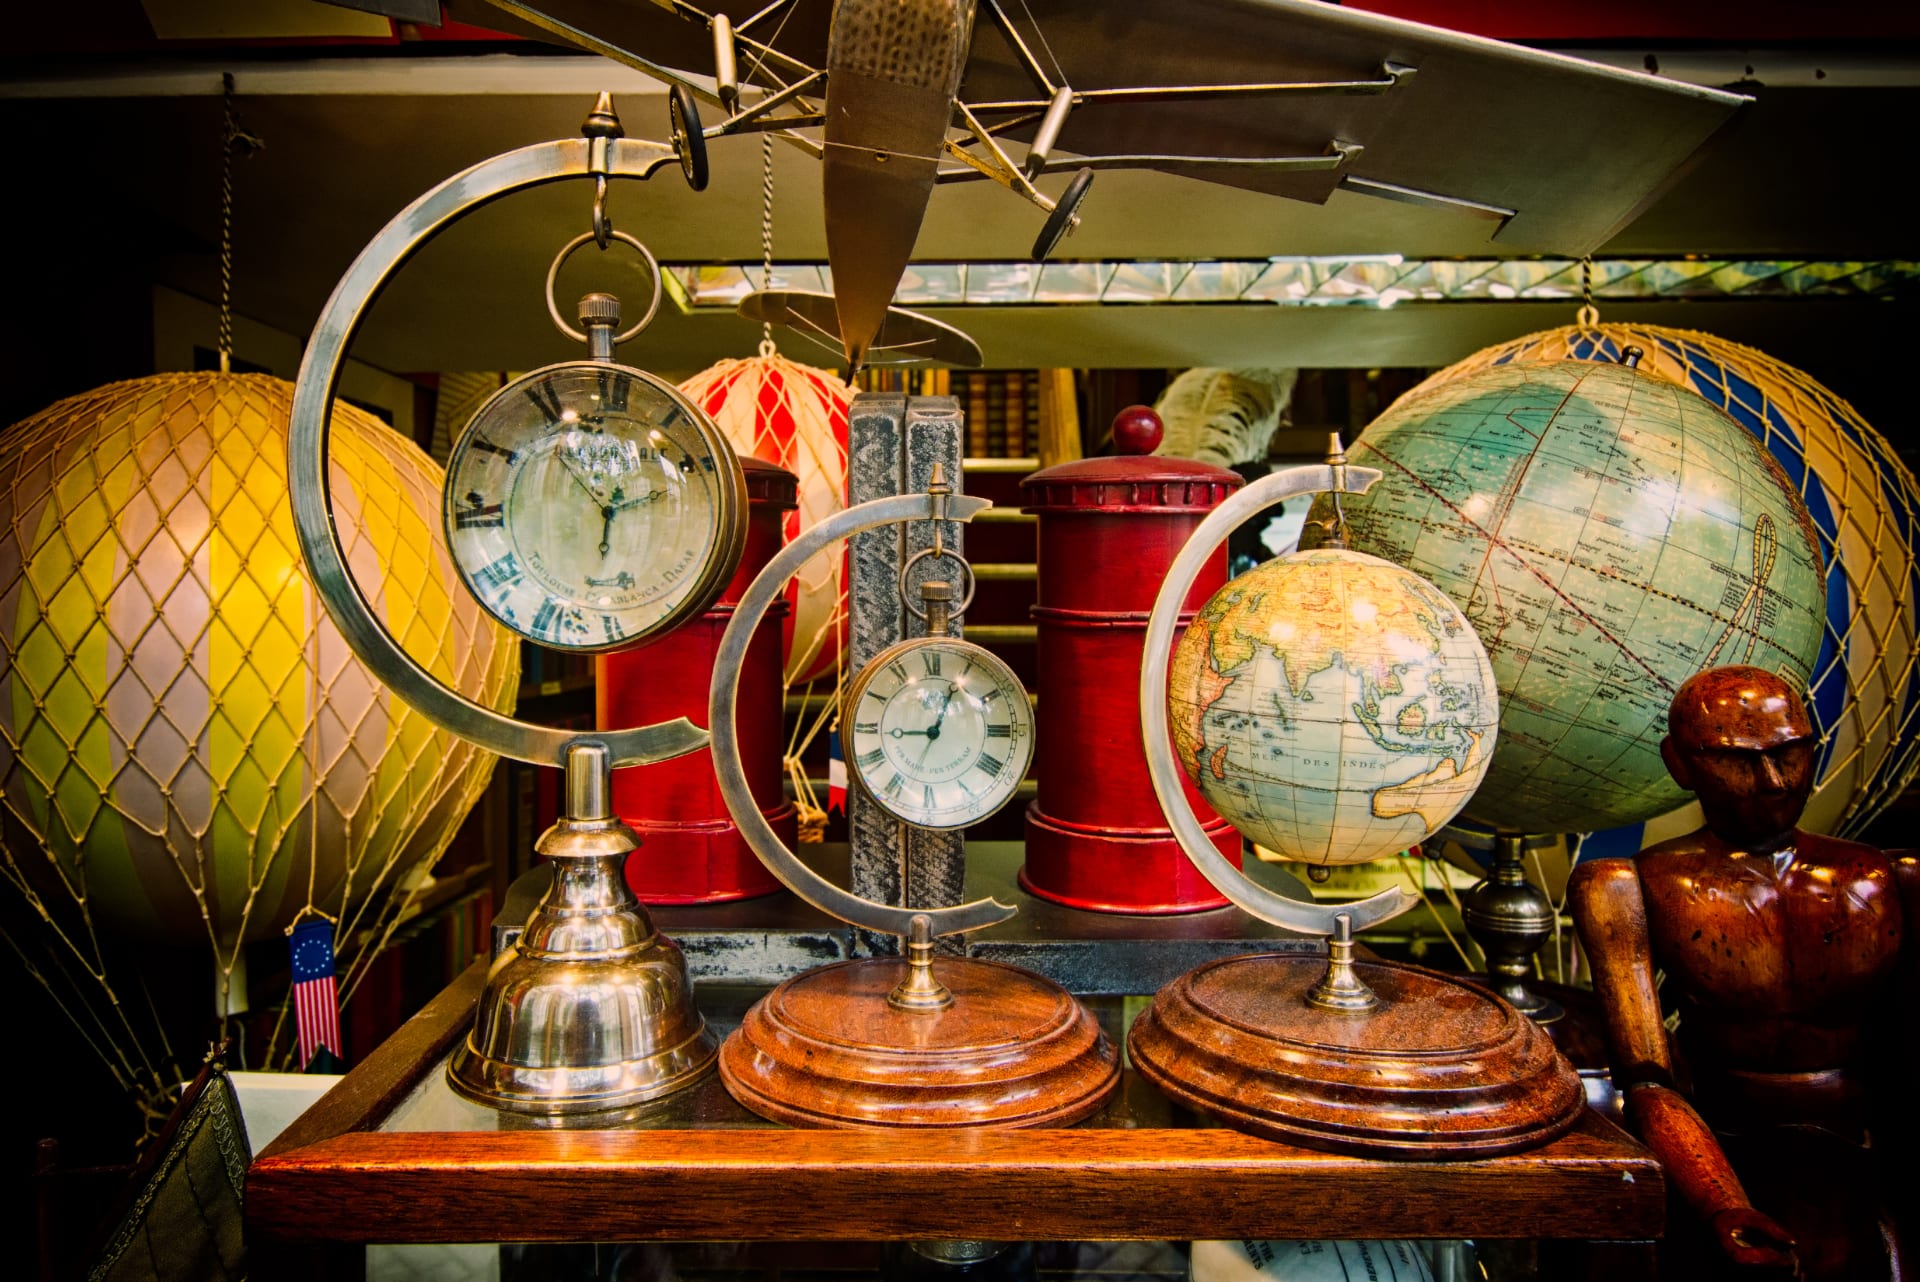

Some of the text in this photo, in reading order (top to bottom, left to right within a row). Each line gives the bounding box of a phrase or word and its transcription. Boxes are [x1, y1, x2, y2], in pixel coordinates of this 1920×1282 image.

[662, 550, 695, 583] DAKAR
[1252, 752, 1386, 770] MER DES INDES
